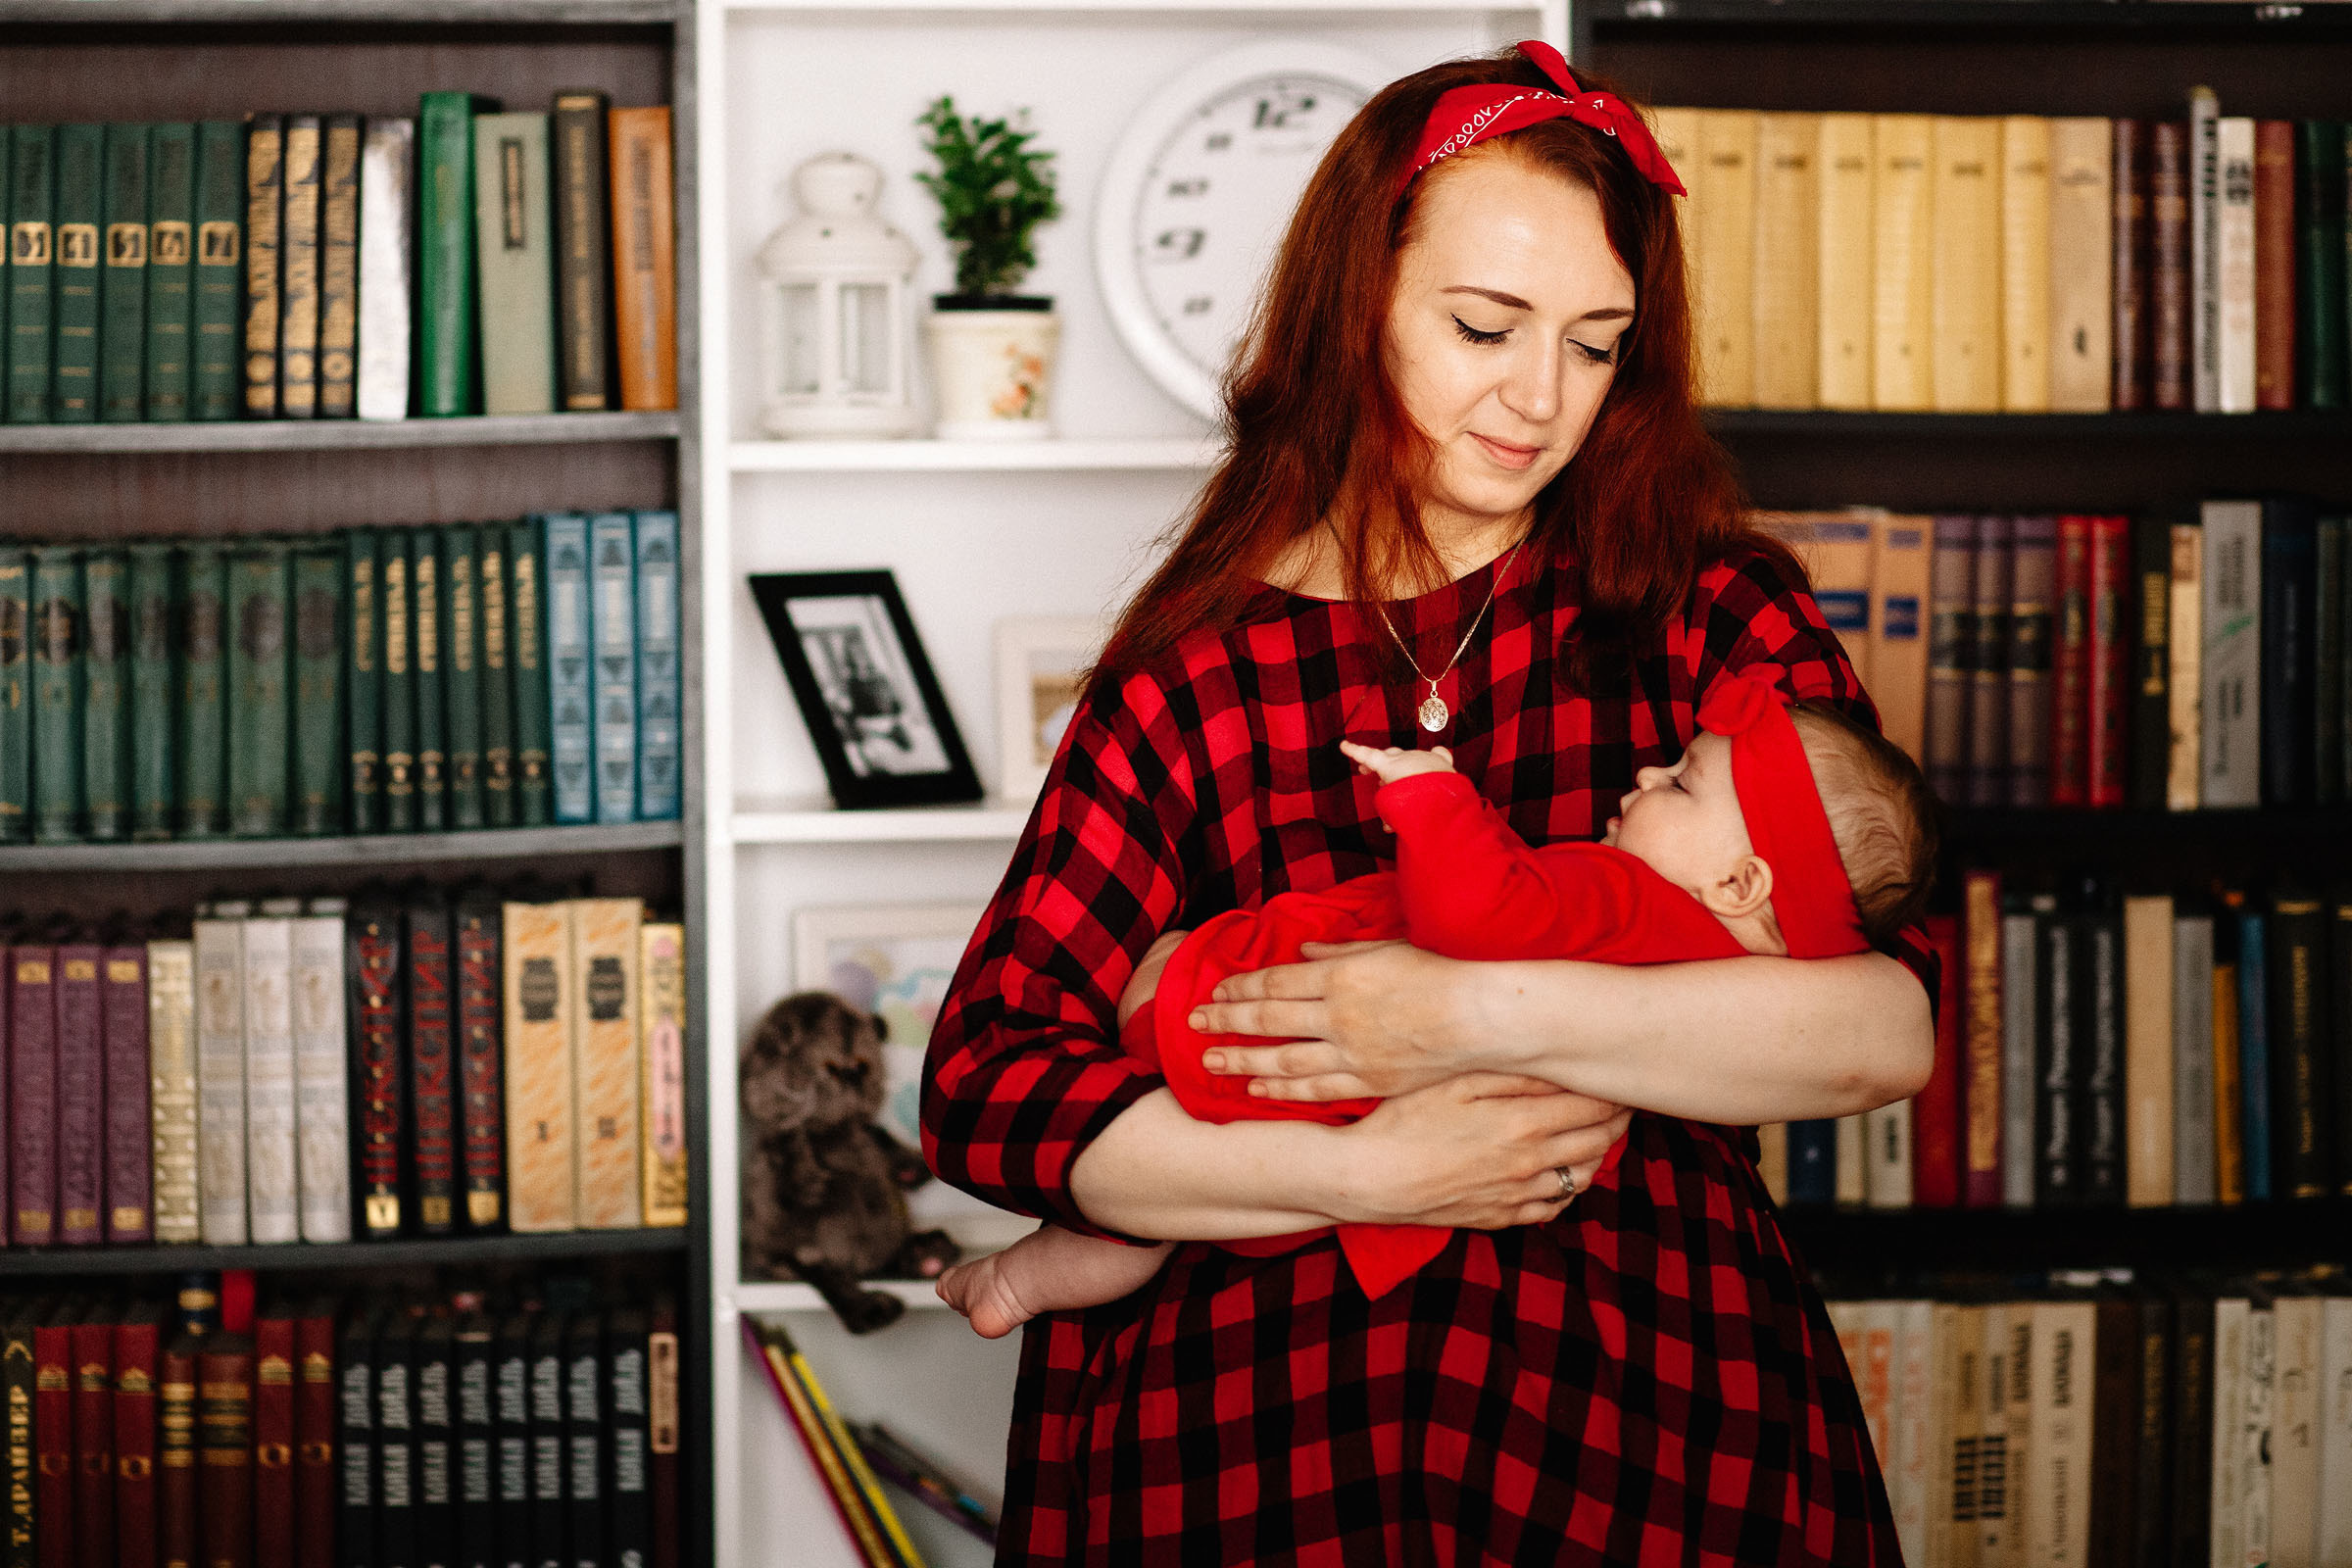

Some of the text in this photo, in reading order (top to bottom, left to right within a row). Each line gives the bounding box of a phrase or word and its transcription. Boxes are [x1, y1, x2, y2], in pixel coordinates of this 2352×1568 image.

[1252, 97, 1316, 129] 12
[1157, 228, 1204, 258] 9
[360, 935, 398, 1184] ШЕКСПИР
[413, 930, 452, 1180] ШЕКСПИР
[461, 929, 500, 1177] ШЕКСПИР
